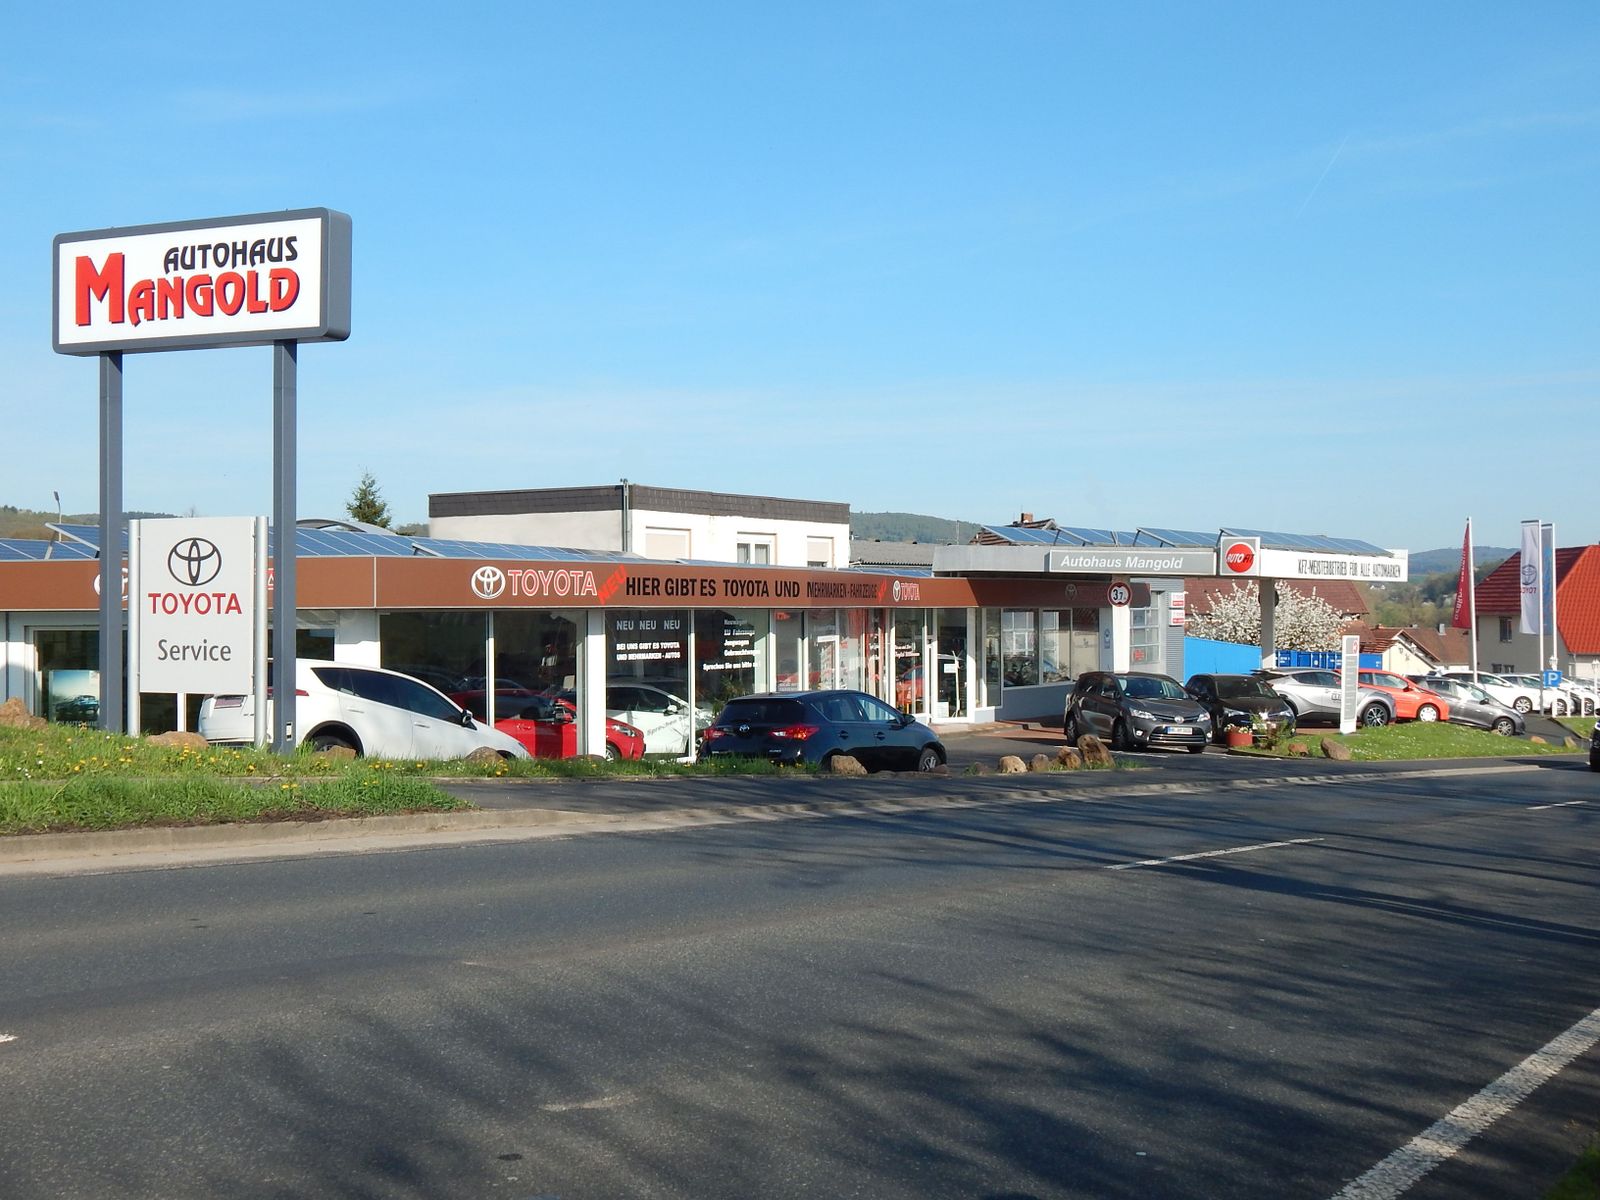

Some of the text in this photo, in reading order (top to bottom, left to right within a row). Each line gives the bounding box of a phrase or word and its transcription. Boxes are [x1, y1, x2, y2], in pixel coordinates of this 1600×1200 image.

[164, 236, 297, 274] AUTOHAUS
[75, 252, 300, 327] MANGOLD
[1060, 555, 1183, 571] Autohaus Mangold
[1360, 563, 1371, 577] ALLE
[508, 569, 597, 596] TOYOTA
[597, 564, 628, 605] NEU
[626, 577, 660, 596] HIER
[665, 578, 697, 597] GIBT
[700, 579, 716, 597] ES
[723, 579, 769, 597] TOYOTA
[775, 580, 800, 598] UND
[148, 592, 242, 615] TOYOTA
[616, 619, 680, 631] NEU NEU NEU
[157, 639, 232, 661] Service
[1548, 673, 1559, 685] P
